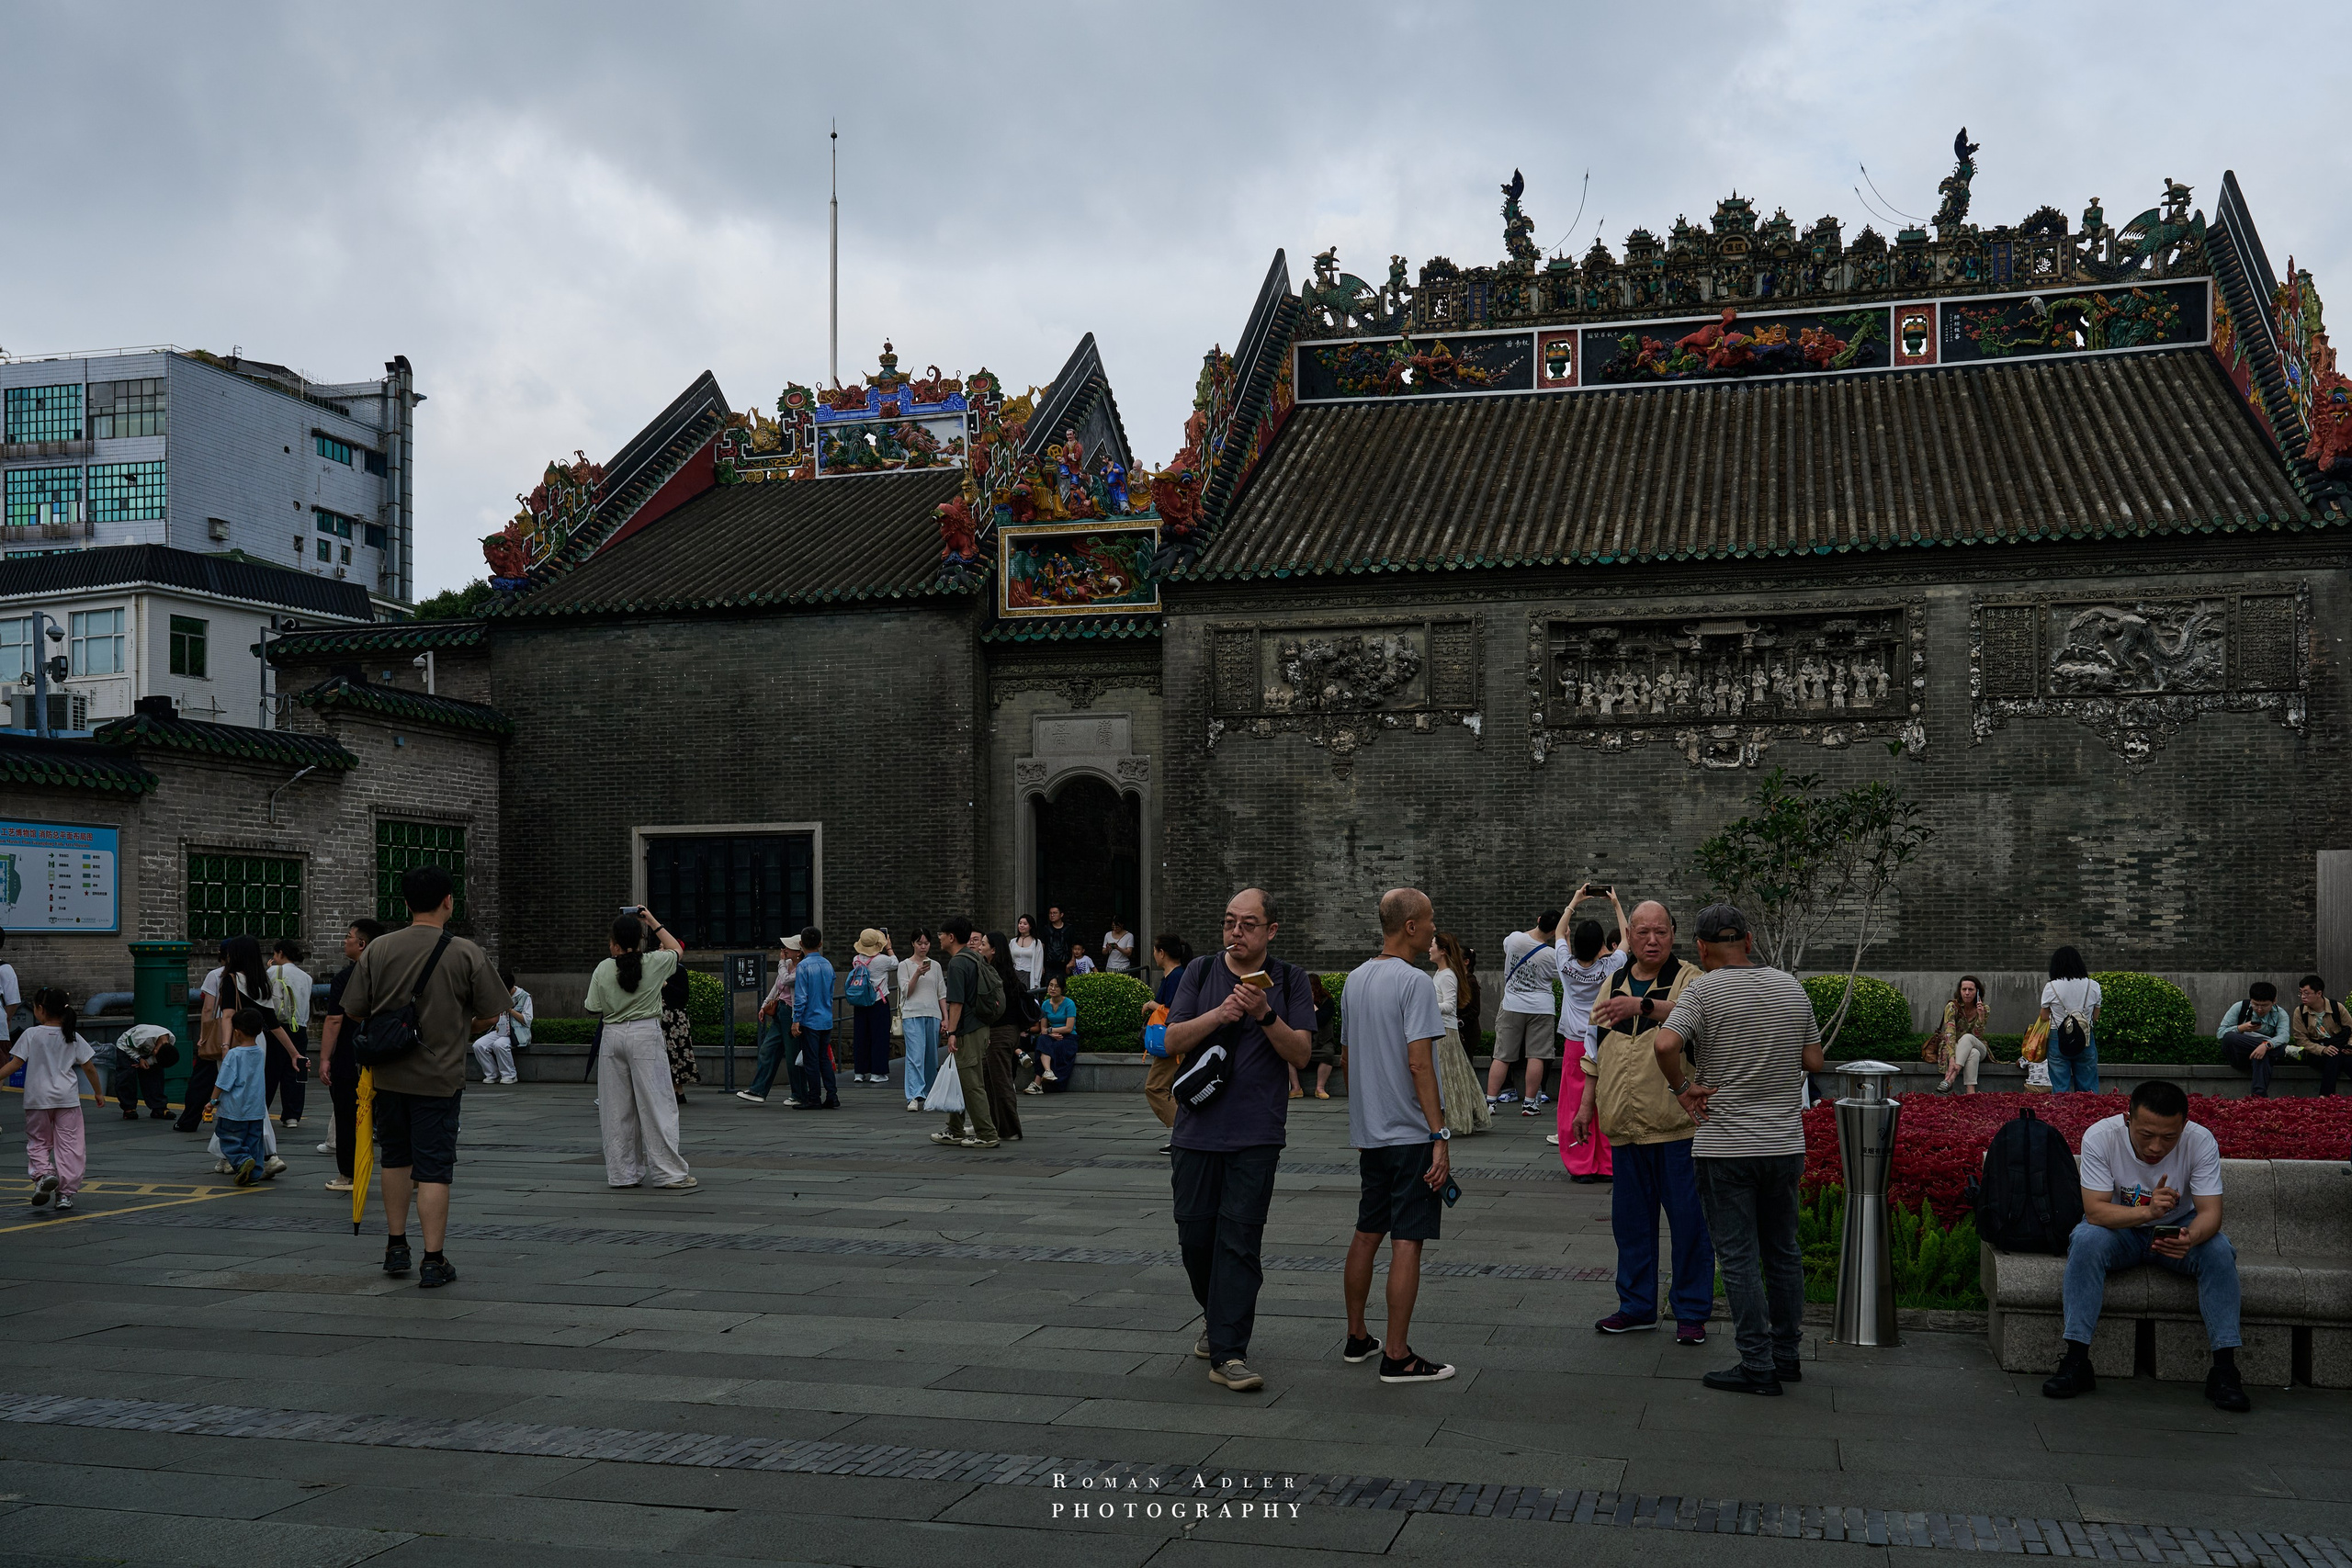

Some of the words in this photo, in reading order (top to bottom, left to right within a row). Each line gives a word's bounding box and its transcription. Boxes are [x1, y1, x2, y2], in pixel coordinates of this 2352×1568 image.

[1, 828, 37, 838] 工艺博物馆
[39, 829, 93, 841] 消防总平面布局图
[1190, 1083, 1216, 1105] PUMA
